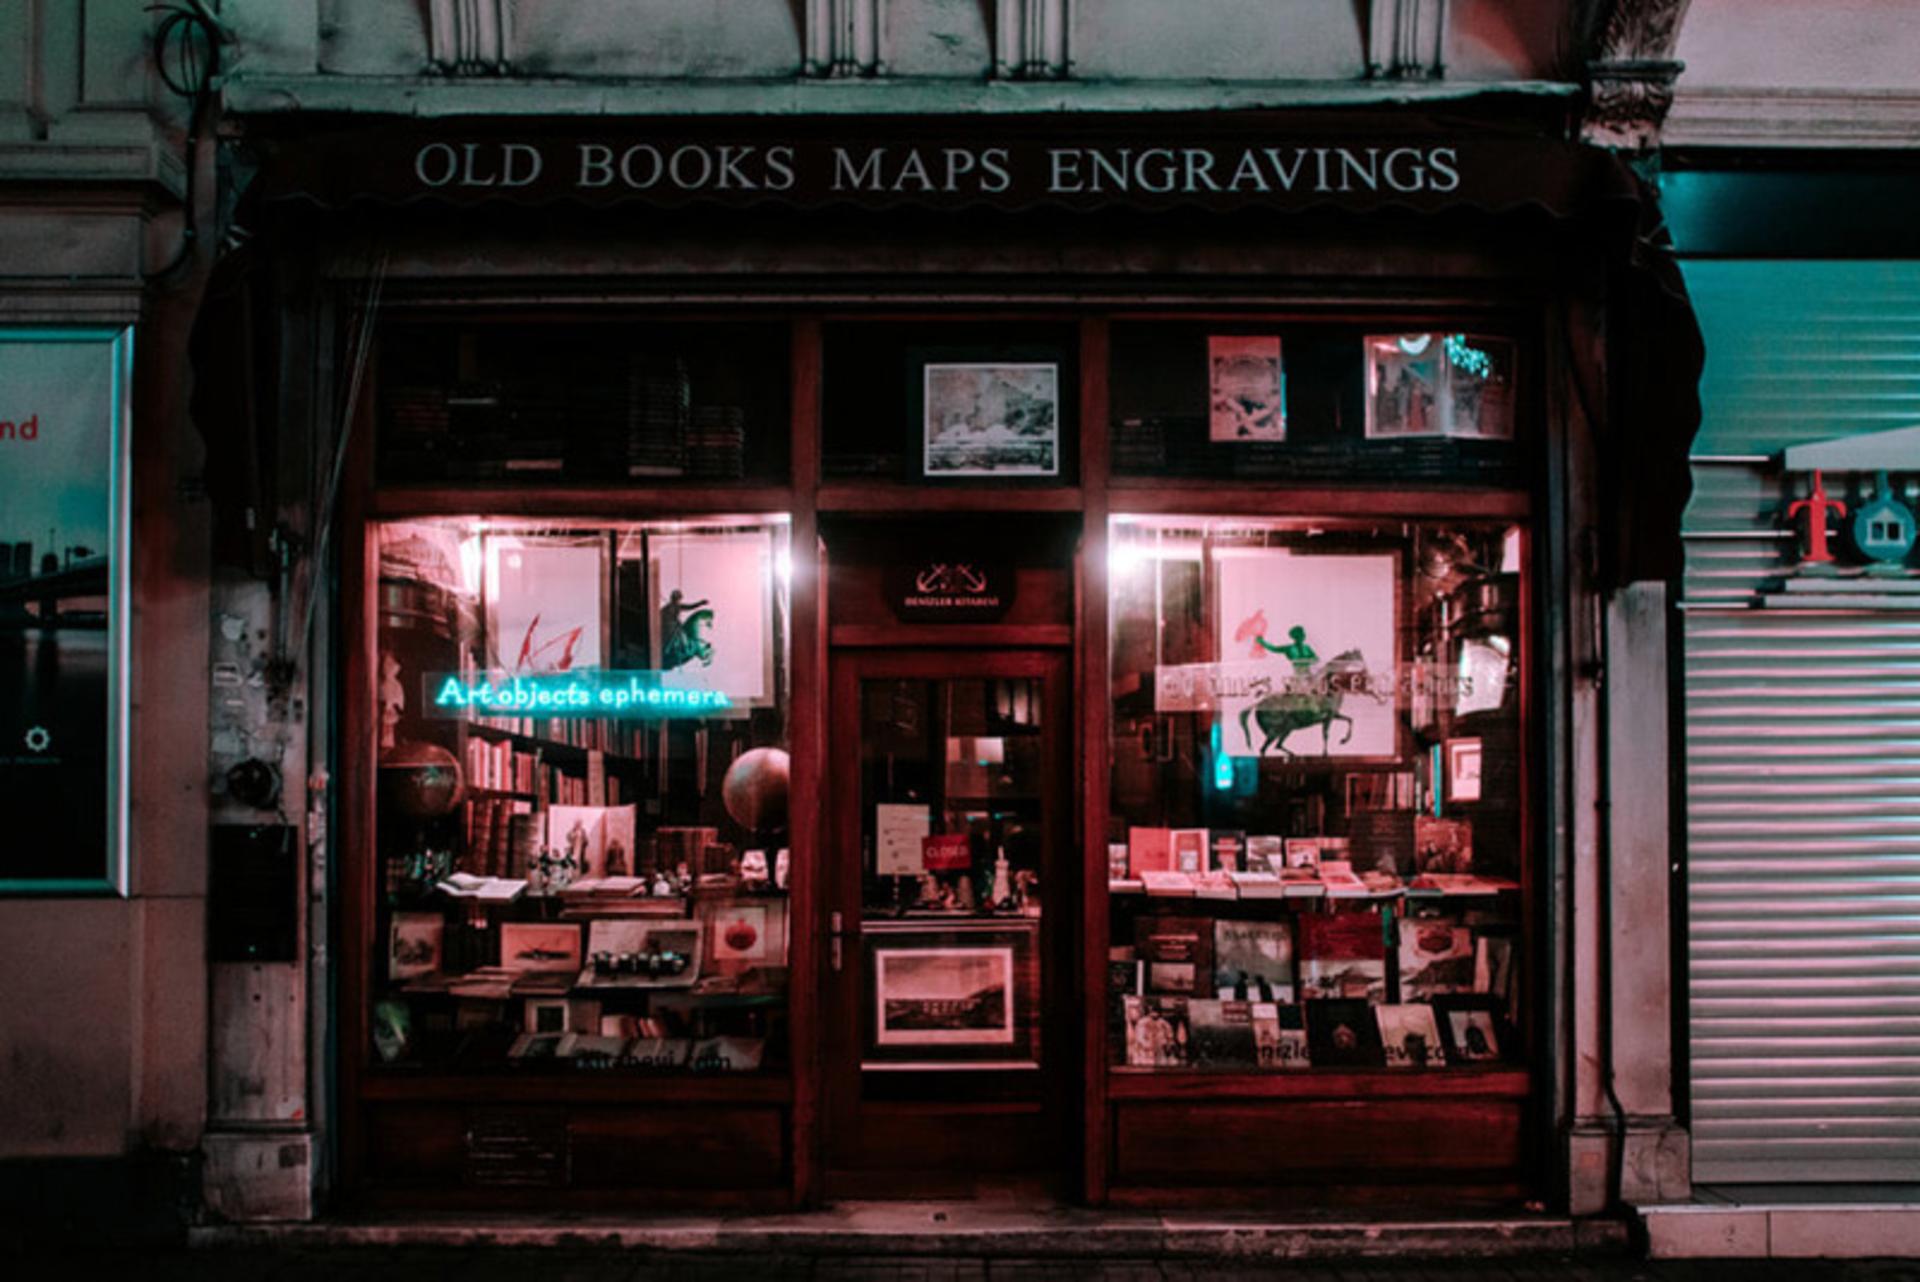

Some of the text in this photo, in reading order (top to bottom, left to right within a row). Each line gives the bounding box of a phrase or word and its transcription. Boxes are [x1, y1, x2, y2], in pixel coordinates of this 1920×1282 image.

[414, 143, 1461, 193] OLD BOOKS MAPS ENGRAVINGS
[436, 677, 730, 710] Art objects ephemera
[925, 845, 969, 859] CLOSED
